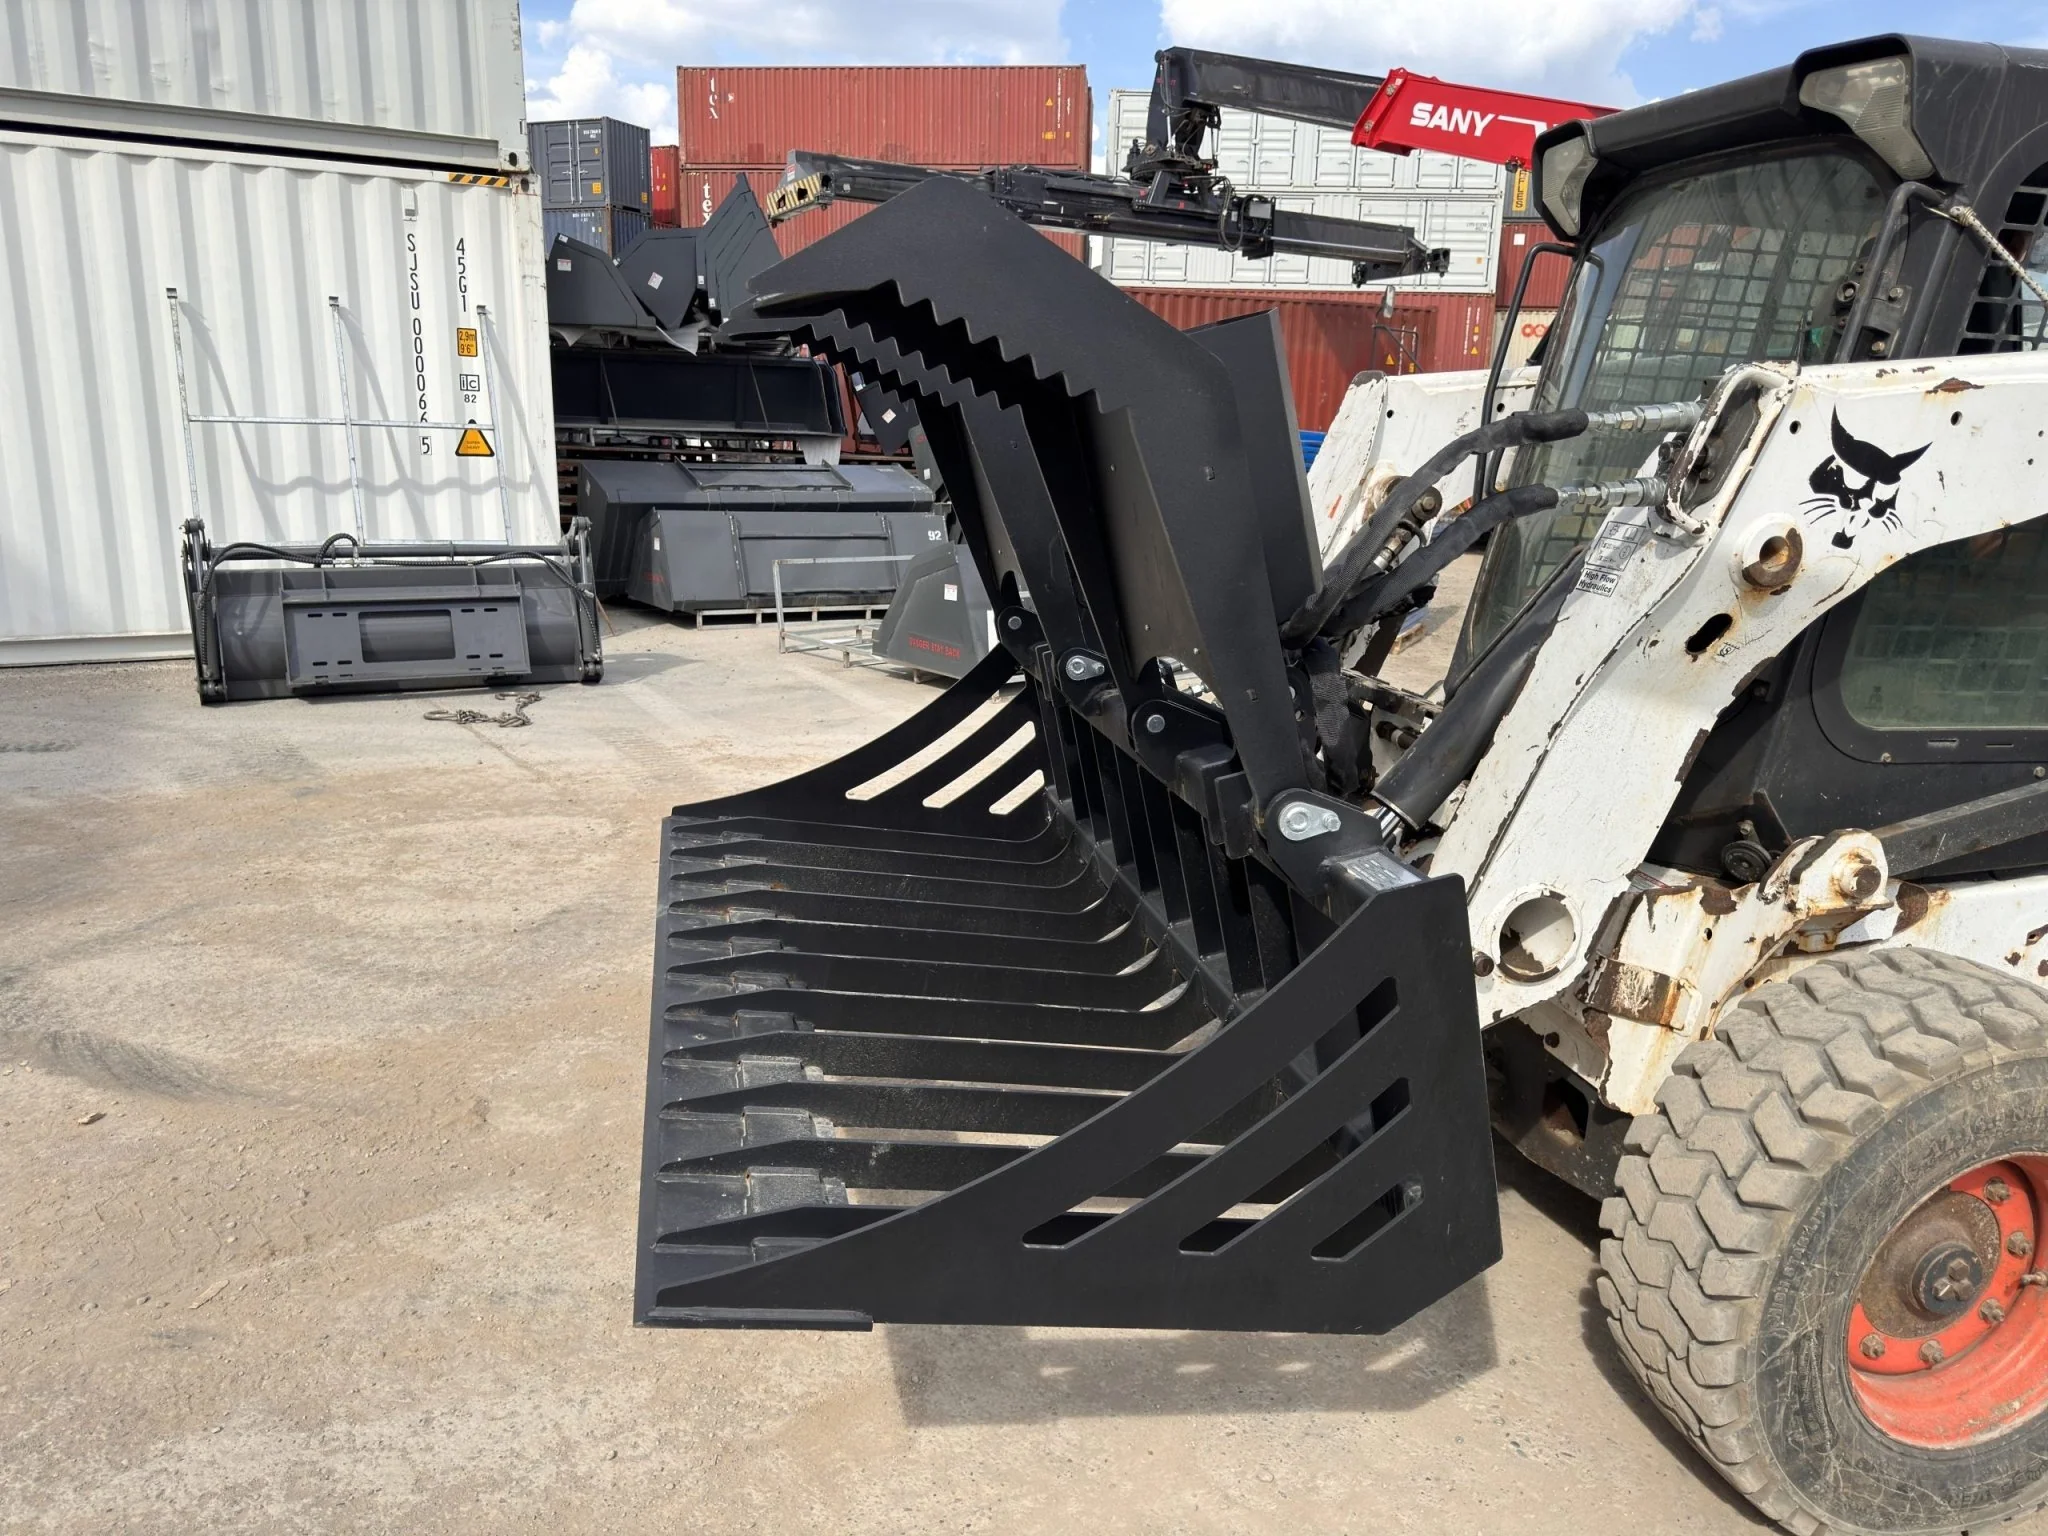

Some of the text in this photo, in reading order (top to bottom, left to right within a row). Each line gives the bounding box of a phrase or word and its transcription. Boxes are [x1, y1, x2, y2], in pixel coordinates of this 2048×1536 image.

[1410, 101, 1496, 137] SANY
[456, 237, 467, 313] 45G1
[407, 233, 420, 310] SJSU
[421, 437, 430, 454] 5
[464, 393, 477, 404] 82
[927, 530, 942, 541] 92
[1584, 570, 1617, 584] High Flow
[1578, 579, 1612, 593] Hydraulics
